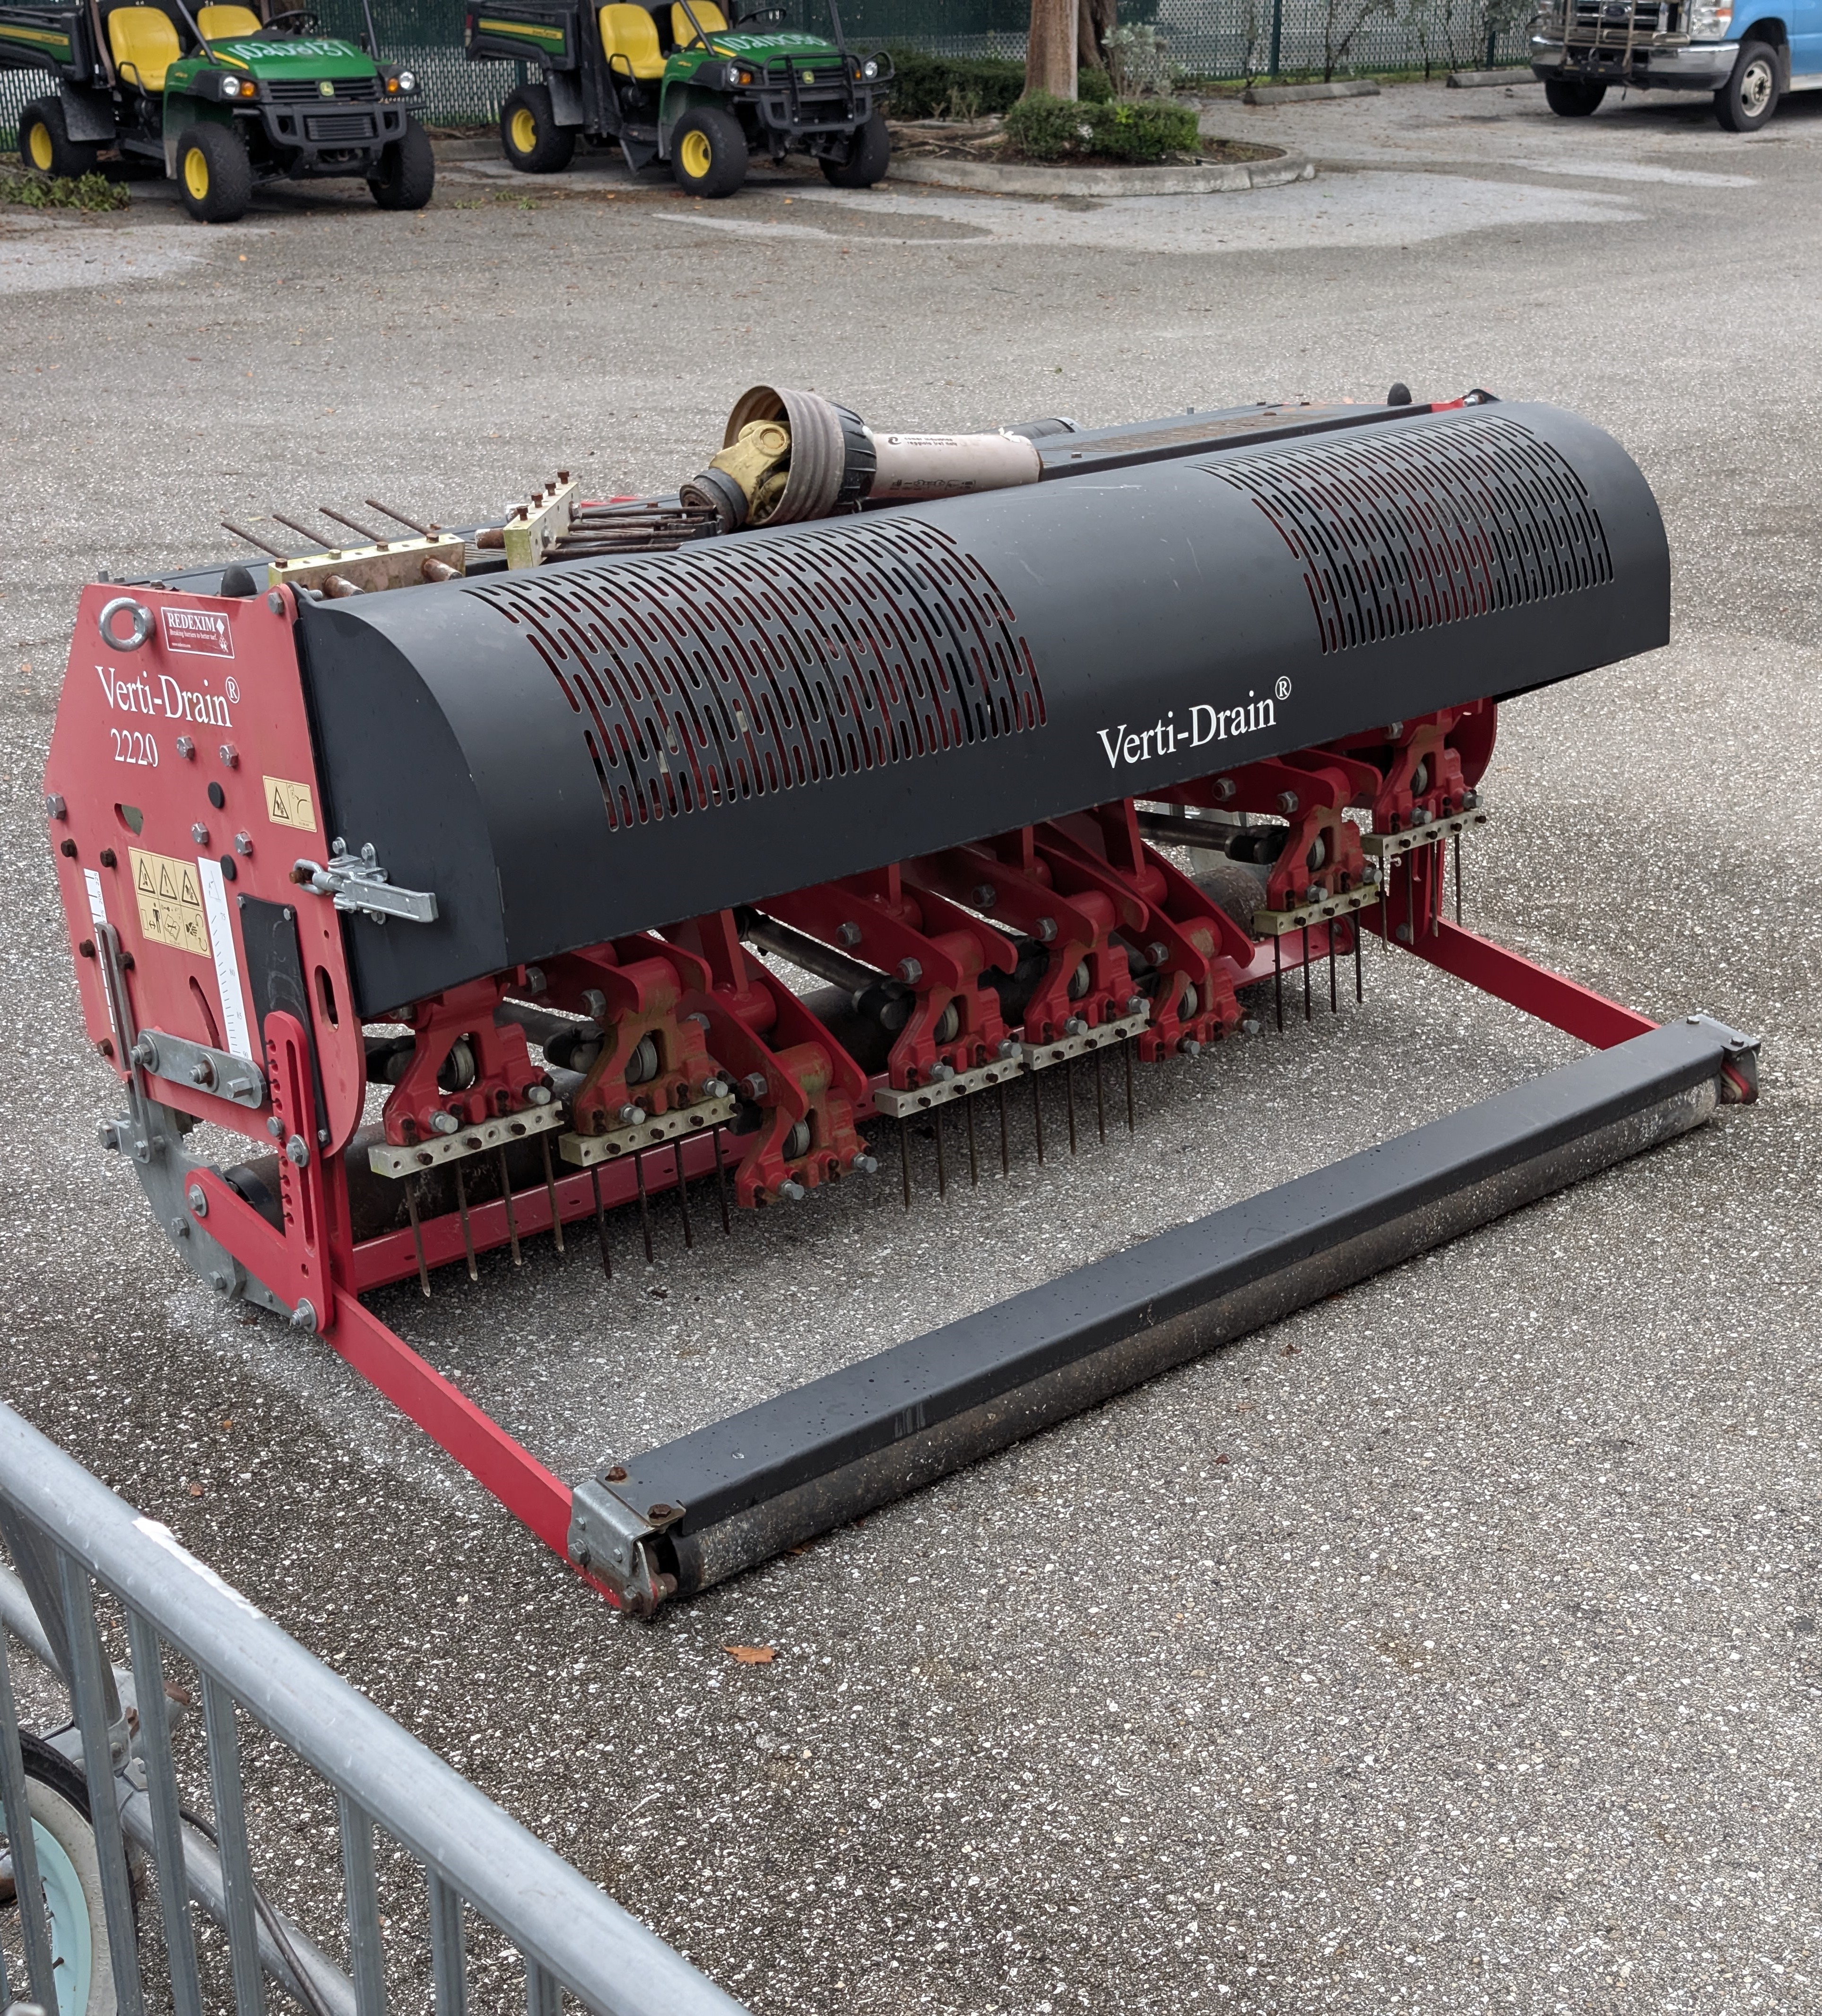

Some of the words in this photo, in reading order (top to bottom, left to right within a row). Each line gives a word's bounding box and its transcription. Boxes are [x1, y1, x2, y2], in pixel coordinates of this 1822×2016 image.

[167, 613, 216, 632] REDEXIM
[170, 629, 184, 638] Breaking
[111, 728, 158, 767] 2220
[220, 912, 226, 921] 75
[229, 969, 235, 977] 80
[237, 1012, 242, 1020] 85
[243, 1051, 249, 1059] 90
